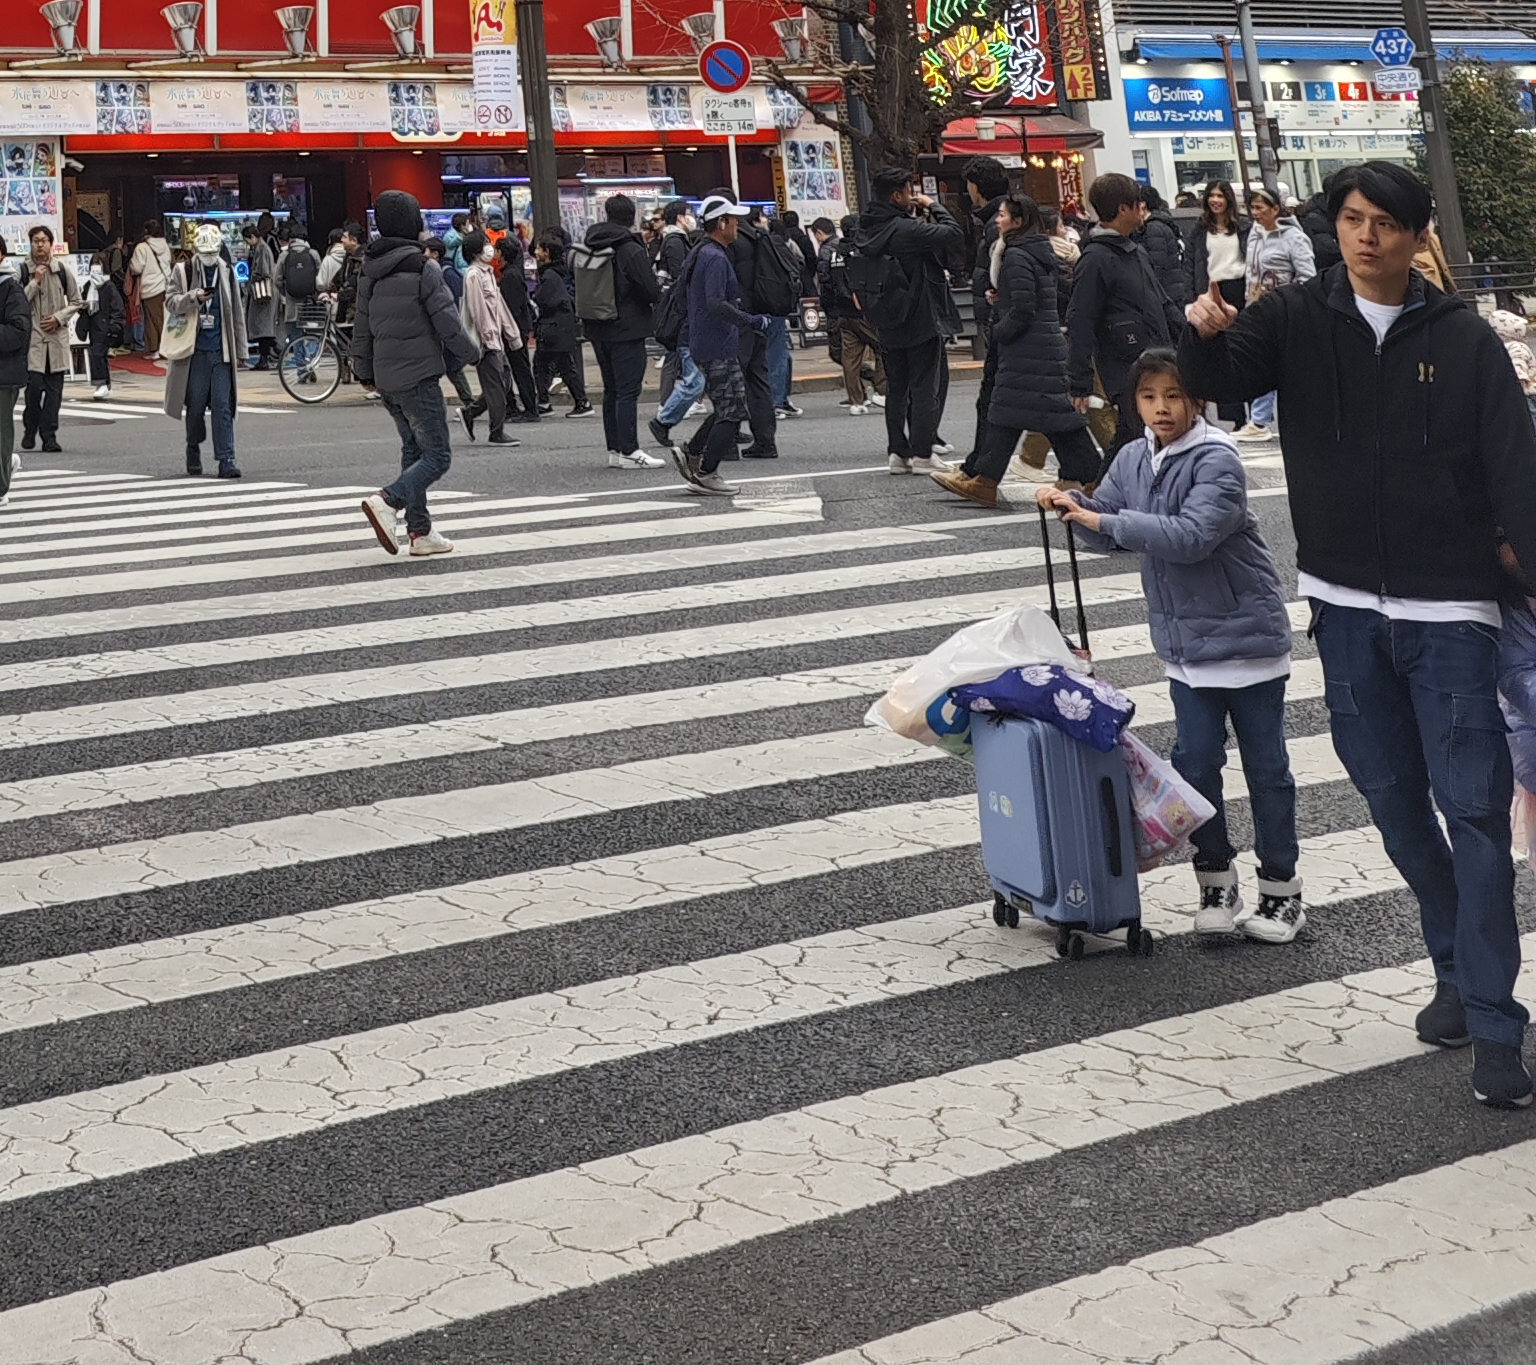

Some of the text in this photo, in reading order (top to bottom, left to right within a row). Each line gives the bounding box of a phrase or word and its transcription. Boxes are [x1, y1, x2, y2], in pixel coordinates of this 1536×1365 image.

[1375, 38, 1408, 55] 437
[1377, 72, 1417, 83] 中央通り
[1162, 86, 1204, 105] Sofmap
[1279, 82, 1360, 100] 2F 3F 4F
[1134, 110, 1224, 123] AKIBA アミューズメント館
[706, 121, 754, 132] ここから 14m
